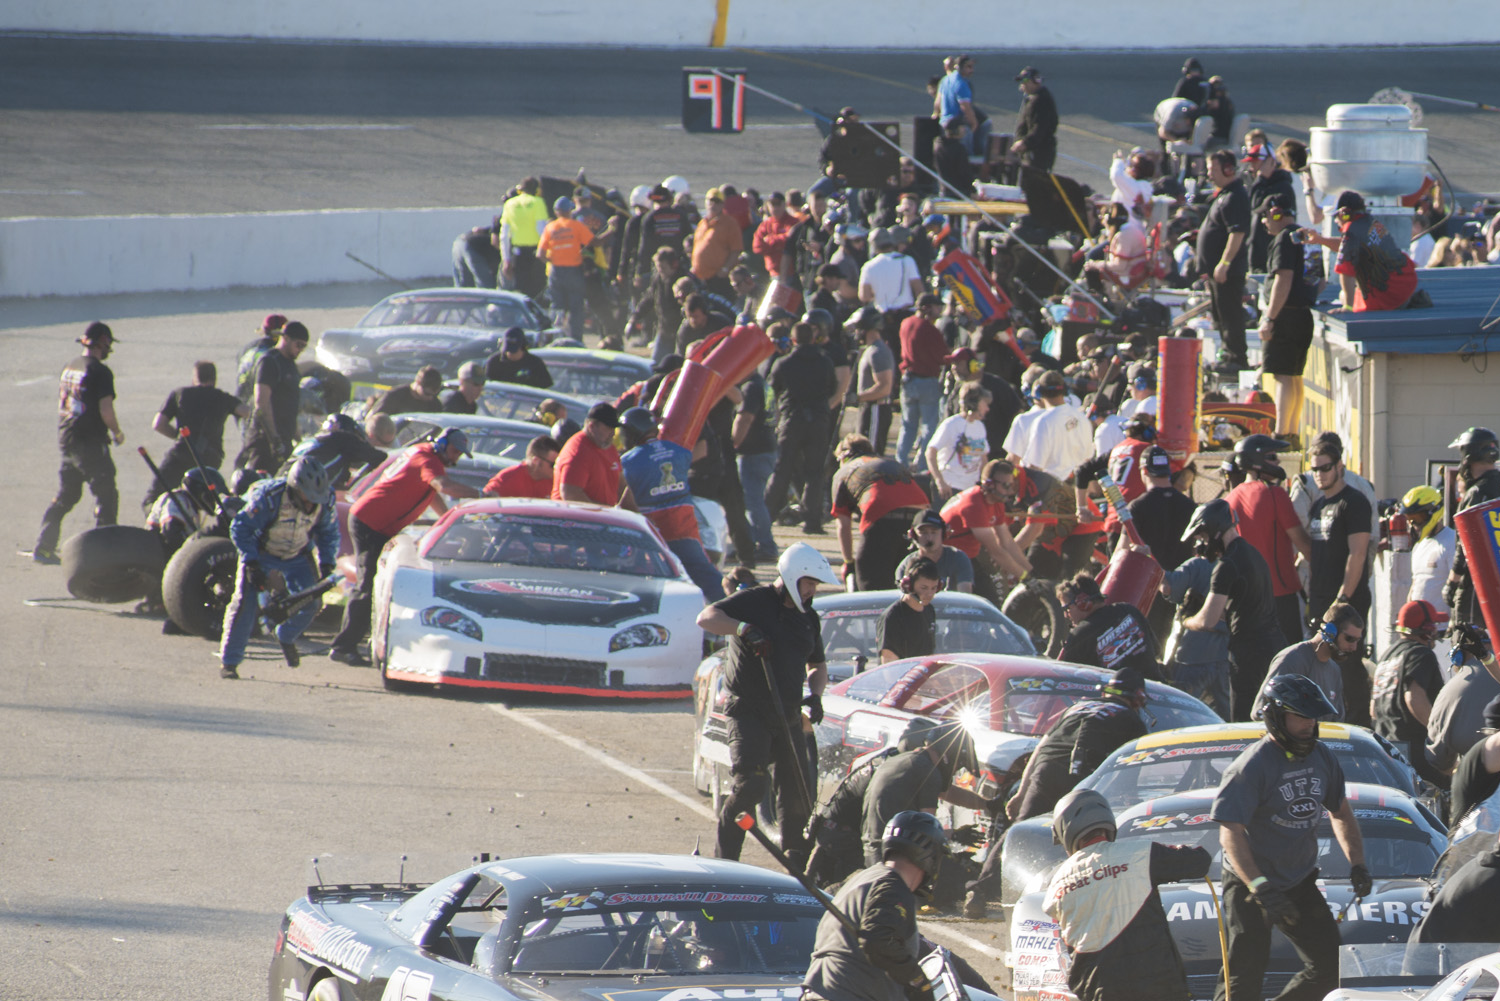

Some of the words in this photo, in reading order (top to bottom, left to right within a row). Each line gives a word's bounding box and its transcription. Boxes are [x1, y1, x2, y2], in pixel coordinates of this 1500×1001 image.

[650, 481, 685, 496] GEICO
[1279, 777, 1322, 801] UTZ
[1291, 802, 1316, 813] XXL
[1093, 863, 1129, 881] Clips
[604, 892, 701, 906] SNOWBALL
[702, 892, 767, 904] DERBY
[1016, 936, 1058, 950] MAHLE
